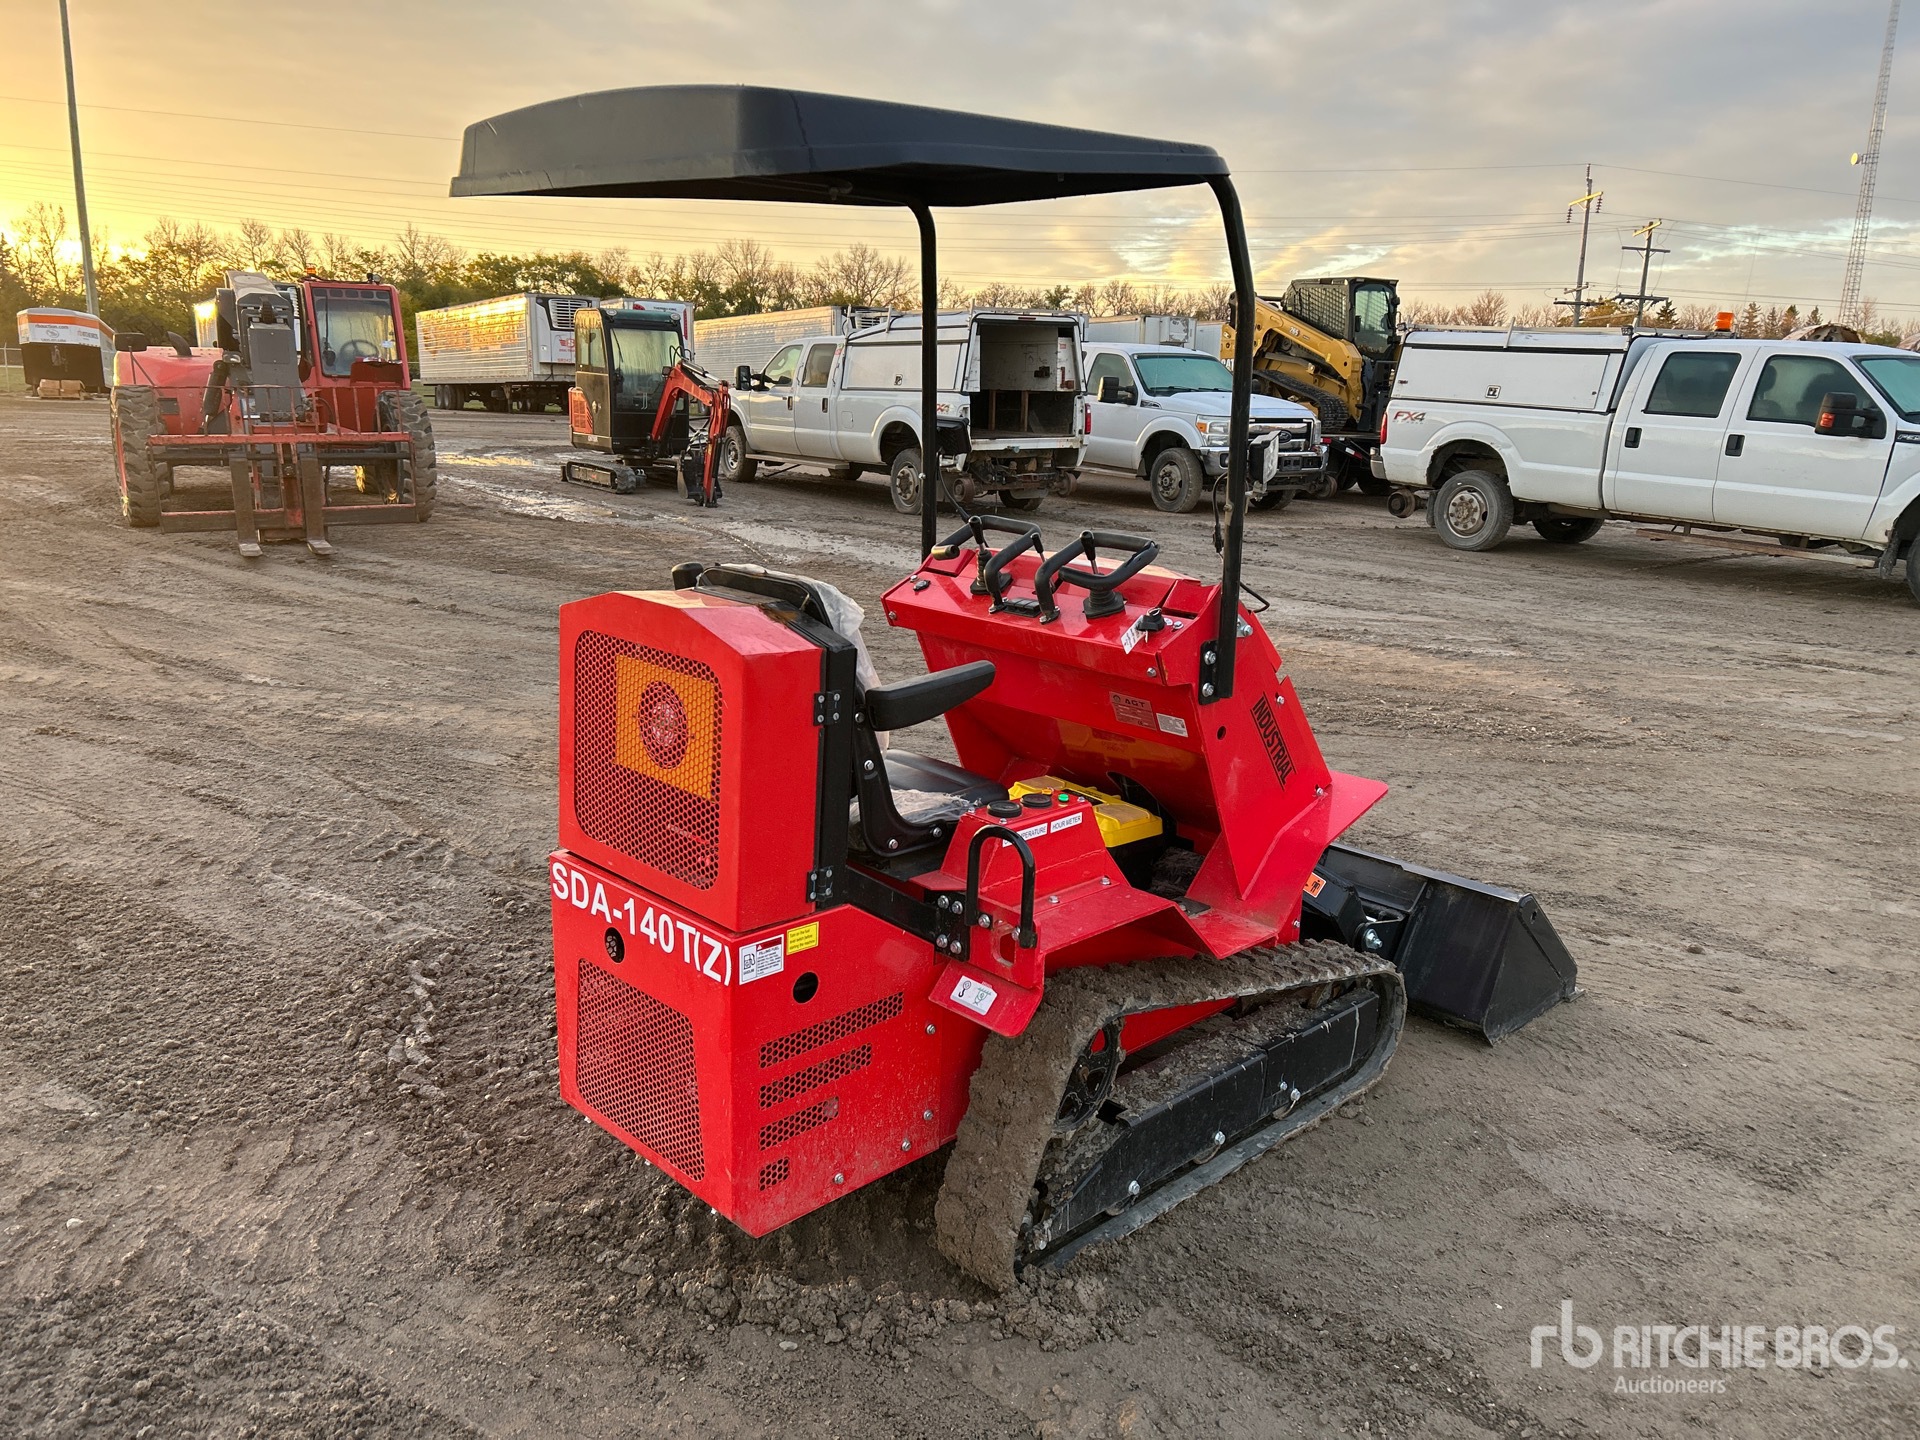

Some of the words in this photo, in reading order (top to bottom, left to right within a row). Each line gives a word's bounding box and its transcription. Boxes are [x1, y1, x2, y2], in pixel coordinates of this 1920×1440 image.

[937, 403, 950, 413] X4
[1393, 411, 1426, 421] FX4
[1125, 698, 1145, 708] AGT
[1252, 696, 1293, 785] INDUSTRIAL
[1052, 820, 1065, 831] HOUR
[1066, 815, 1081, 826] METER
[1021, 826, 1047, 839] PERATURE
[552, 862, 732, 986] SDA-140T(Z)
